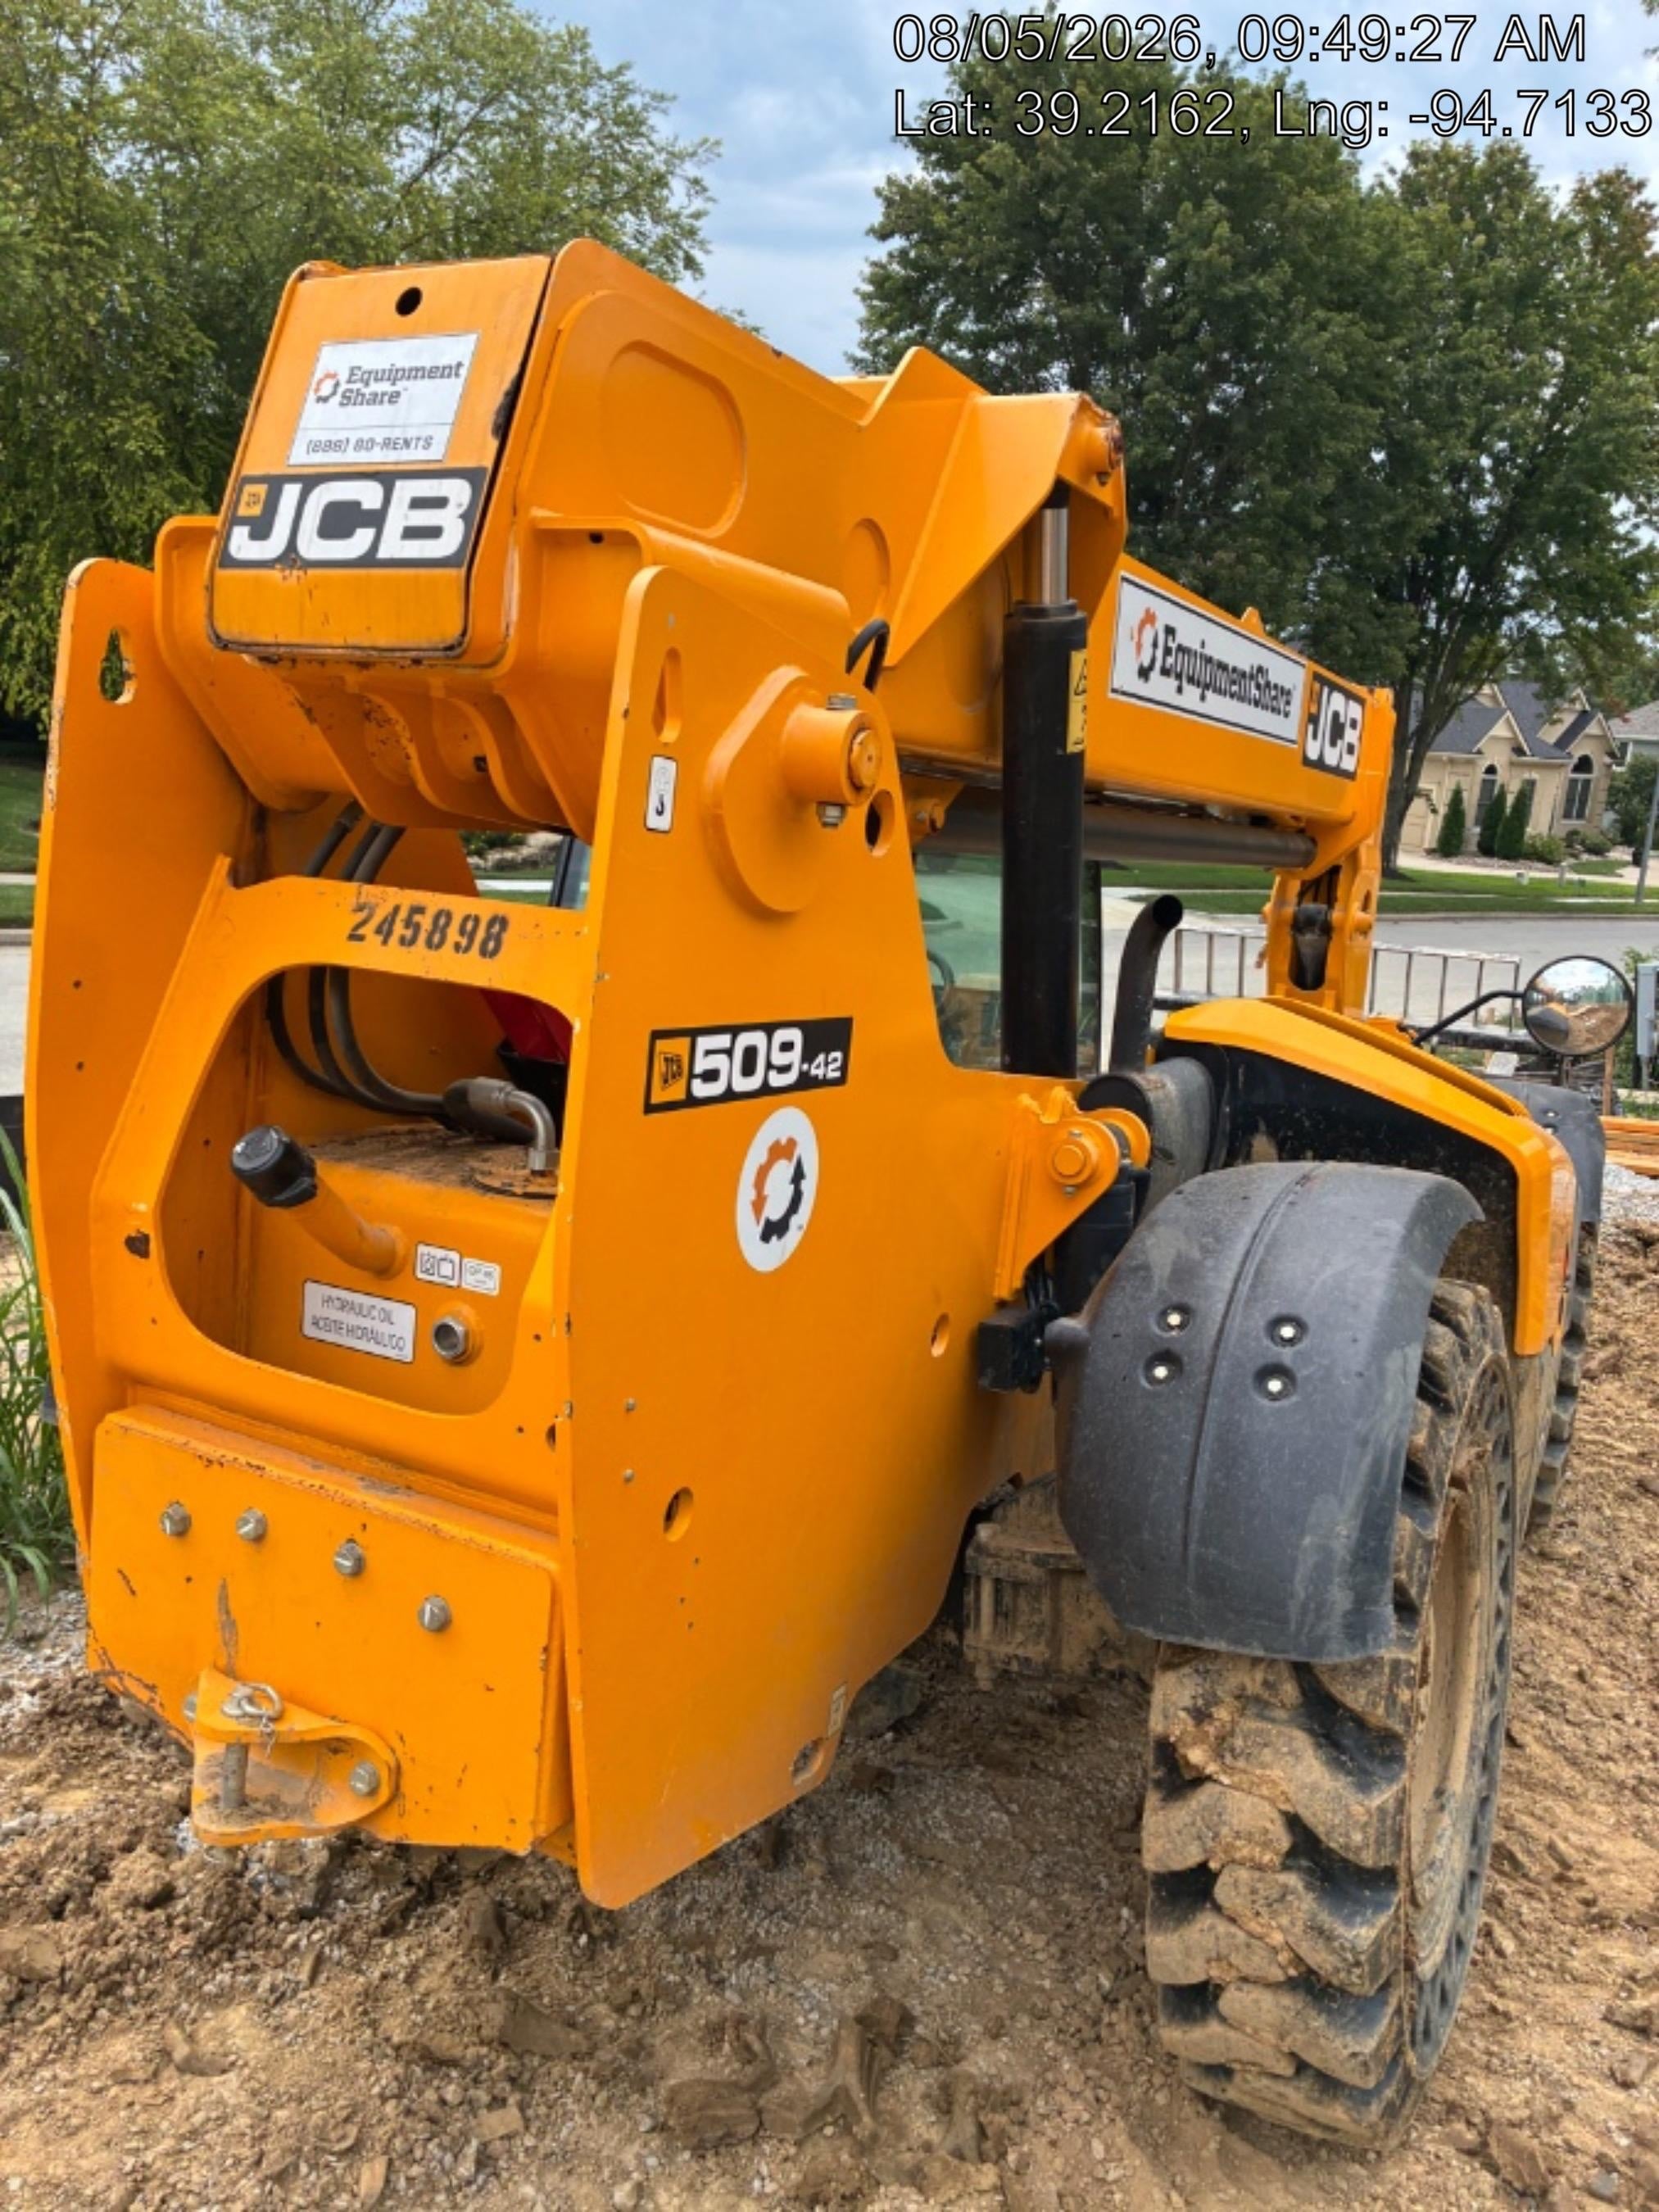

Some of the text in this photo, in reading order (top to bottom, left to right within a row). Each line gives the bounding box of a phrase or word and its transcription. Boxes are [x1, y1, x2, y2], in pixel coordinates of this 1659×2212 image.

[338, 387, 401, 408] Share
[345, 360, 465, 387] Equipment
[228, 478, 473, 561] JCB
[1159, 624, 1292, 718] EquipmentShare
[1305, 684, 1363, 773] JCB
[346, 904, 510, 959] 245898
[321, 1294, 376, 1321] HYDRAULIC
